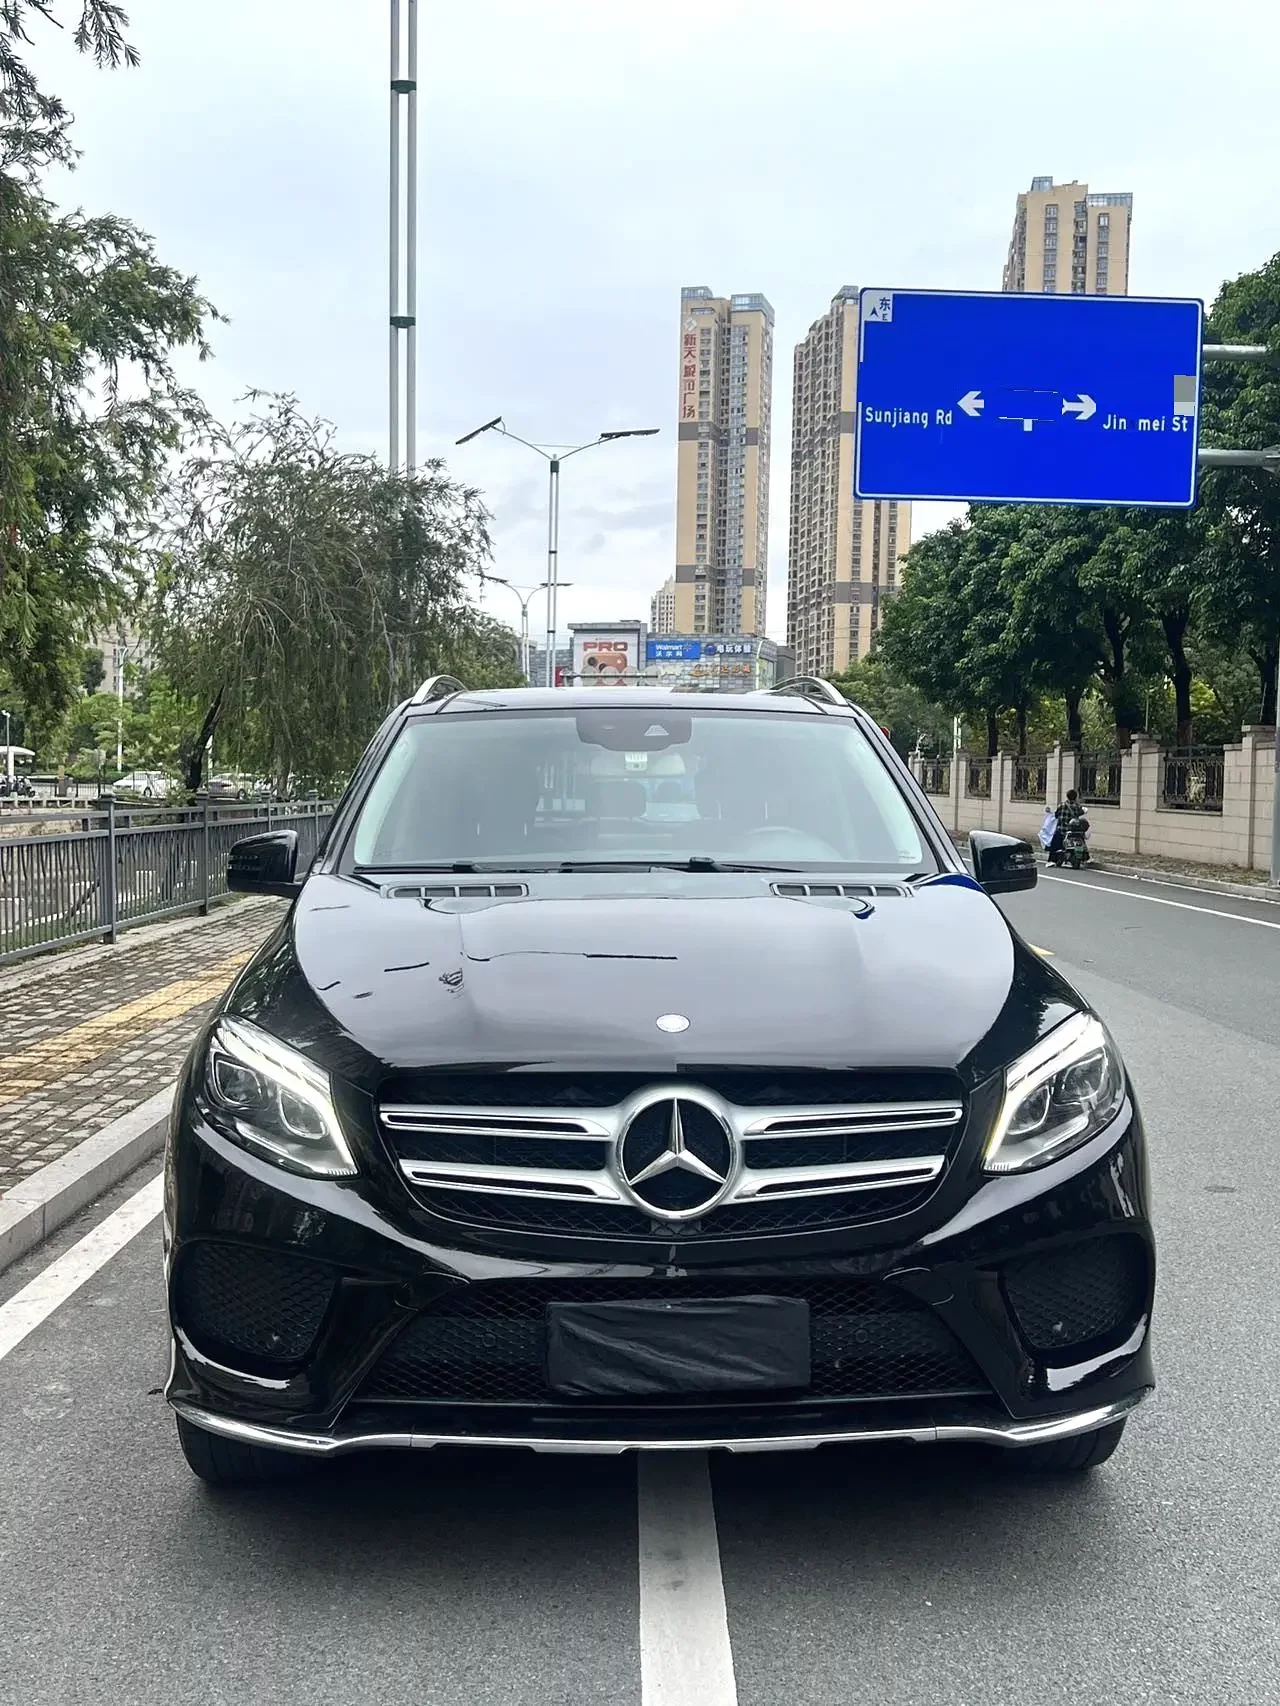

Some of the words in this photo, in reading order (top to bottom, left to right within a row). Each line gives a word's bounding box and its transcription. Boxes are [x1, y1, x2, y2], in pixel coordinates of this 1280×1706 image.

[879, 297, 891, 311] 东
[882, 313, 888, 321] E
[865, 406, 929, 428] Sunjiang
[936, 409, 953, 425] Rd
[1103, 414, 1126, 430] Jin
[1138, 416, 1165, 431] mei
[1172, 416, 1188, 432] St
[583, 642, 628, 651] PRO
